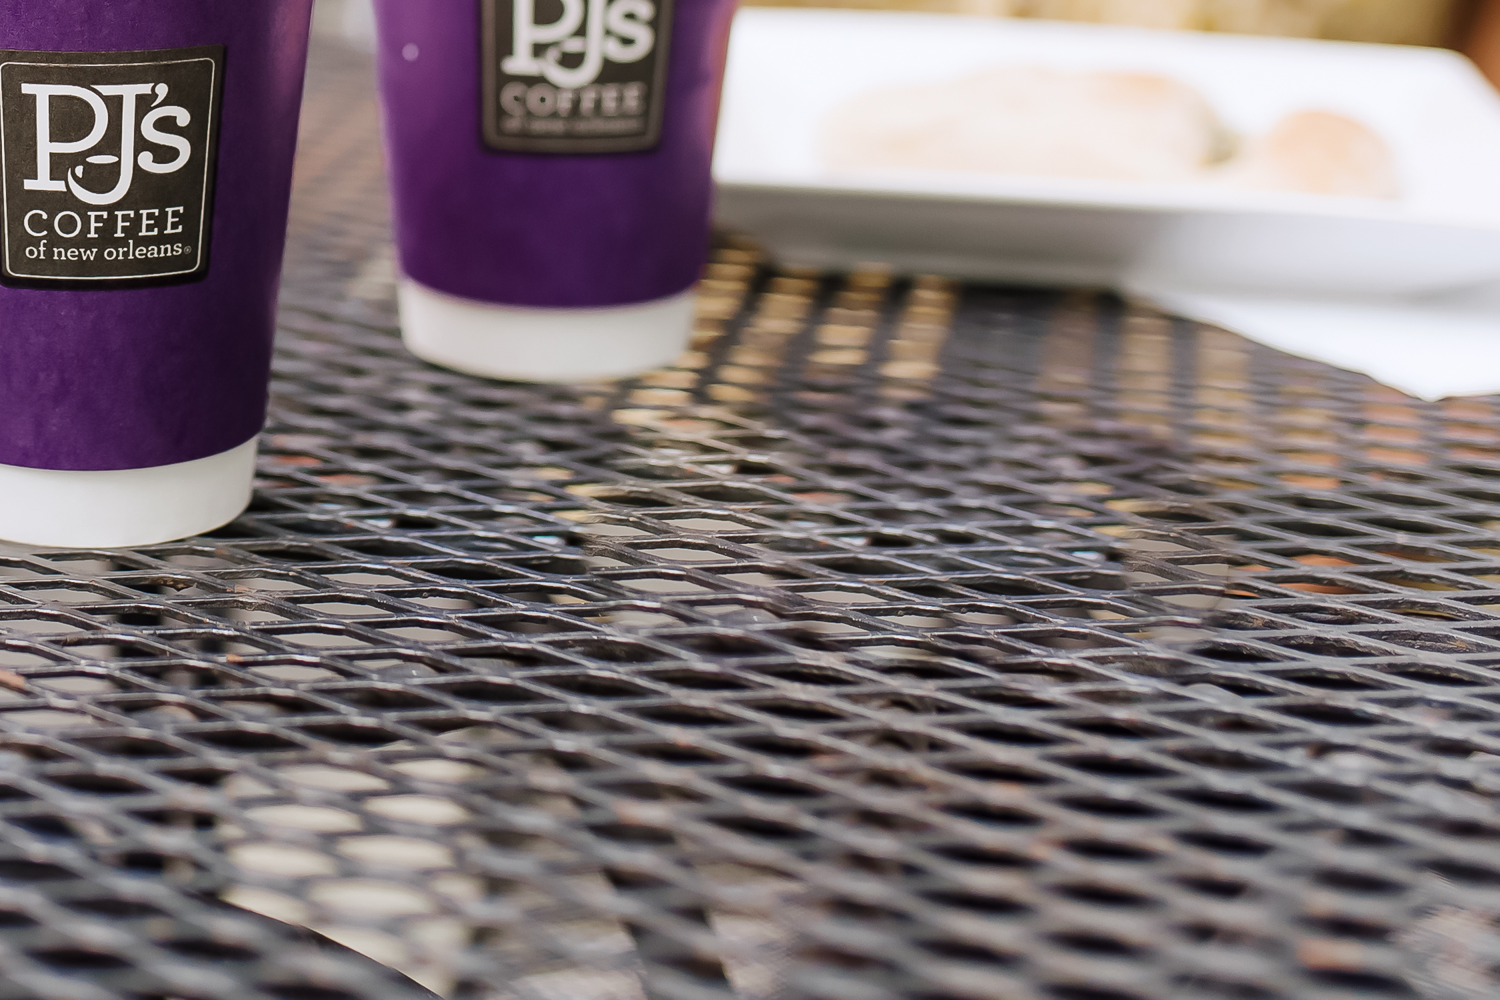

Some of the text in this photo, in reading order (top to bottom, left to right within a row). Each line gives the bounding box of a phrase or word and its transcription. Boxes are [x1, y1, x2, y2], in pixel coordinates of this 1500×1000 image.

[20, 83, 192, 206] PJ's
[23, 206, 184, 238] COFFEE
[25, 239, 48, 260] of
[52, 246, 98, 261] new
